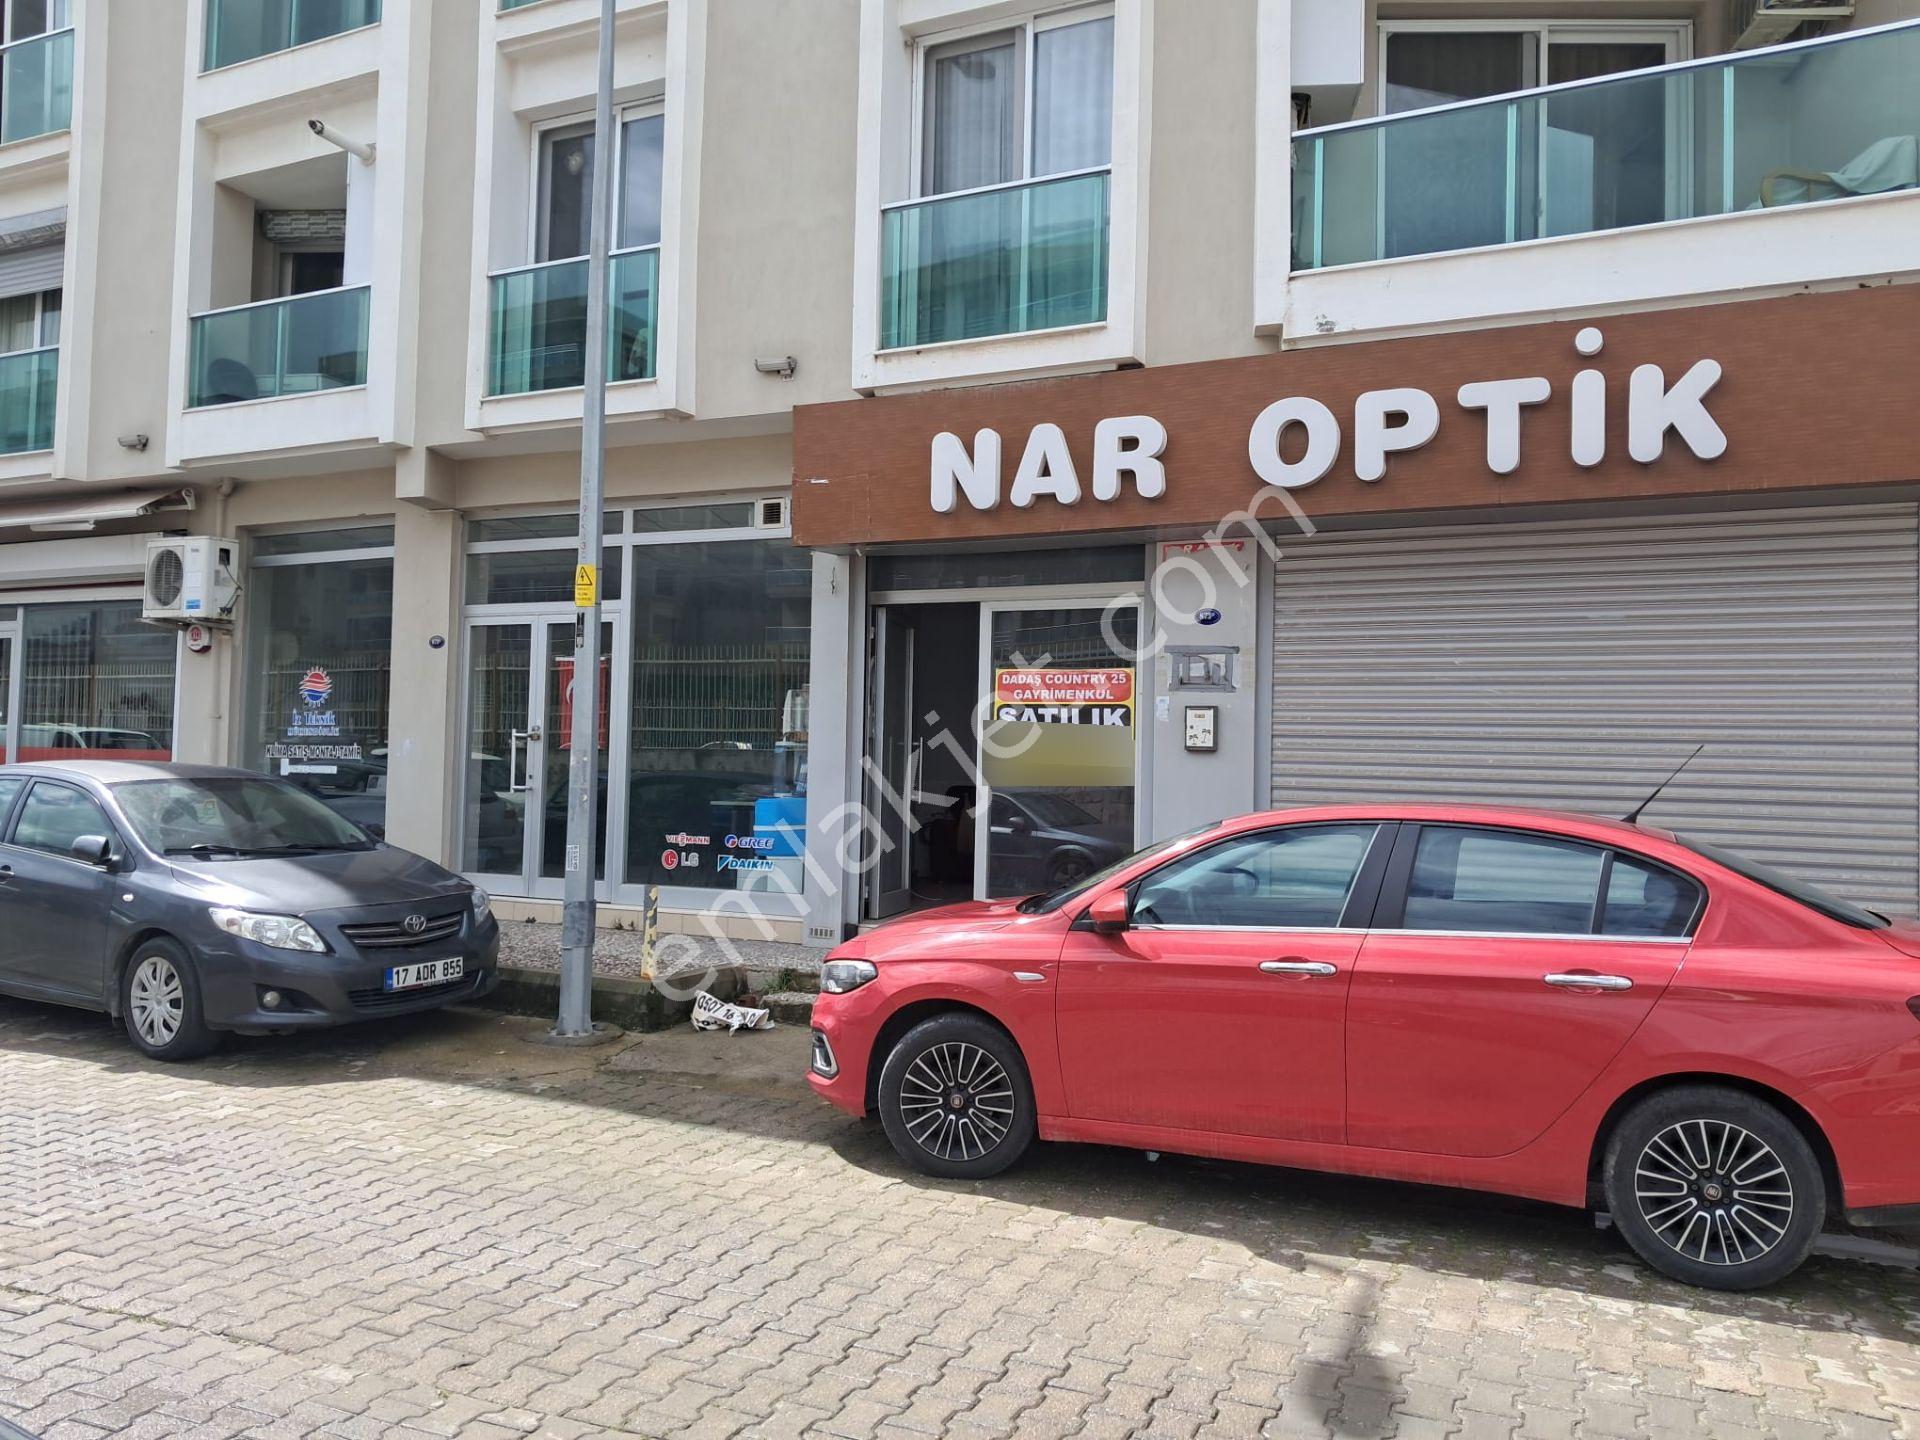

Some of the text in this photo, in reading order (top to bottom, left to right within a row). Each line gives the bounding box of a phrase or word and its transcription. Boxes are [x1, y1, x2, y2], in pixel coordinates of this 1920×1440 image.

[930, 327, 1728, 514] NAR OPTİK
[1002, 673, 1127, 686] DADAŞ COUNTRY 25
[738, 837, 775, 849] GREE
[681, 852, 699, 867] LG
[729, 859, 774, 871] DAIKIN
[395, 968, 409, 985] 17
[415, 964, 437, 982] ADR
[442, 959, 462, 977] 855
[697, 995, 725, 1014] 0507
[722, 1008, 735, 1020] 16
